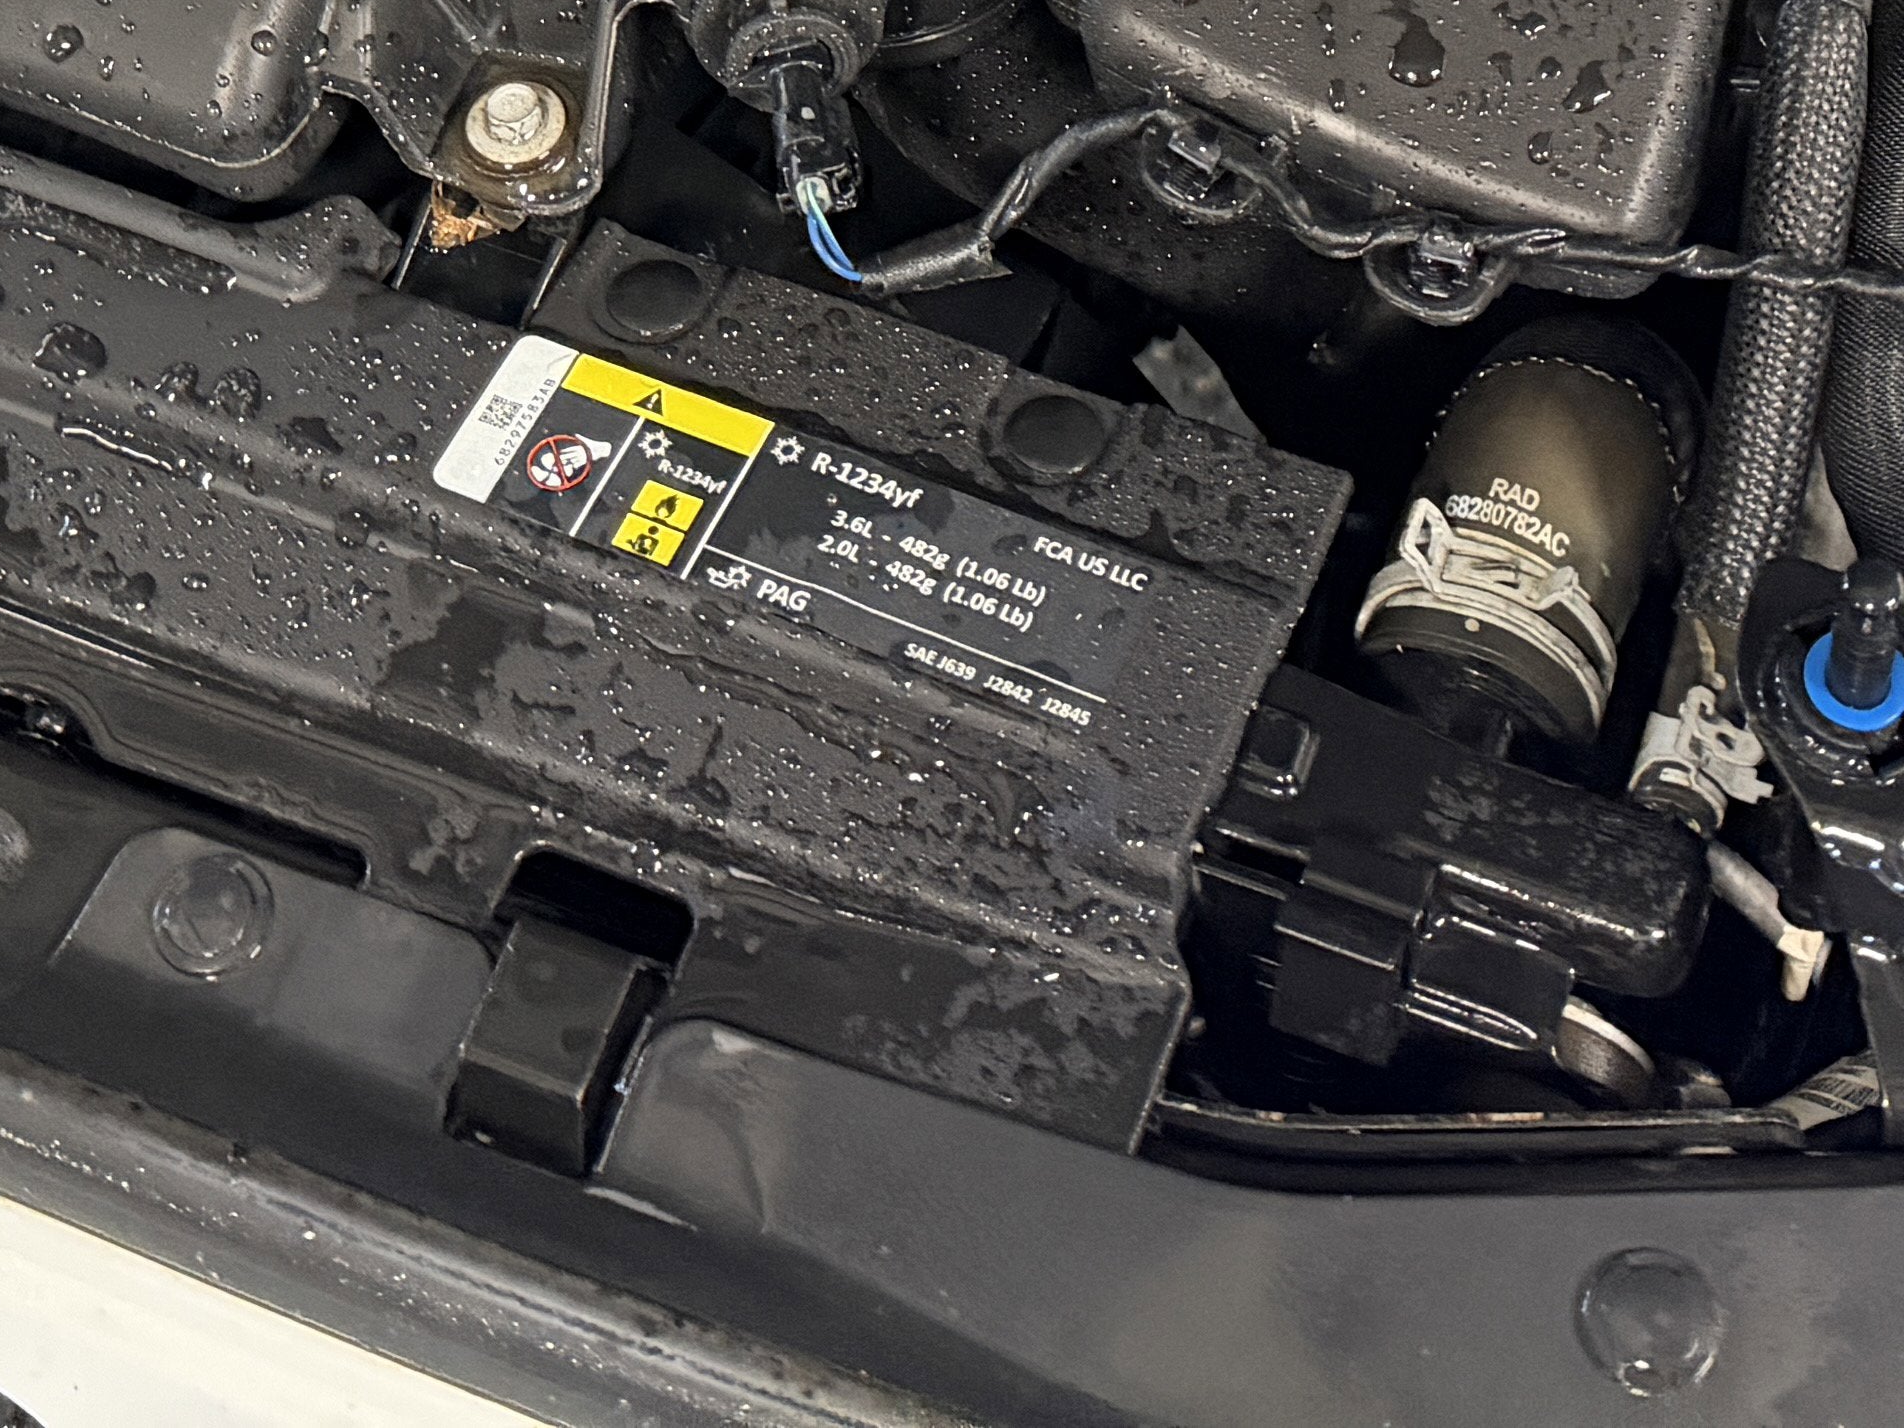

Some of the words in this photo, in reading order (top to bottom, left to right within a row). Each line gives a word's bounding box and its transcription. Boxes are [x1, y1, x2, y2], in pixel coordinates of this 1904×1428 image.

[657, 459, 727, 494] R-1234yf
[809, 451, 925, 509] R-1234yf
[1488, 477, 1540, 511] RAD
[1446, 495, 1570, 557] 68280782AC
[816, 533, 860, 564] 2.0L
[885, 560, 937, 596] 482g
[943, 581, 998, 616] (1.06
[998, 600, 1035, 633] Lb)
[829, 508, 873, 540] 3.6L
[899, 534, 950, 572] 482g
[956, 555, 1011, 590] (1.06
[1011, 576, 1046, 608] Lb)
[1033, 535, 1077, 570] FCA
[1077, 553, 1109, 579] US
[1109, 564, 1149, 592] LLC
[756, 578, 812, 612] PAG
[904, 642, 936, 667] SAE
[936, 655, 977, 682] J639
[983, 674, 1034, 706] J2842
[1041, 696, 1092, 727] J2845
